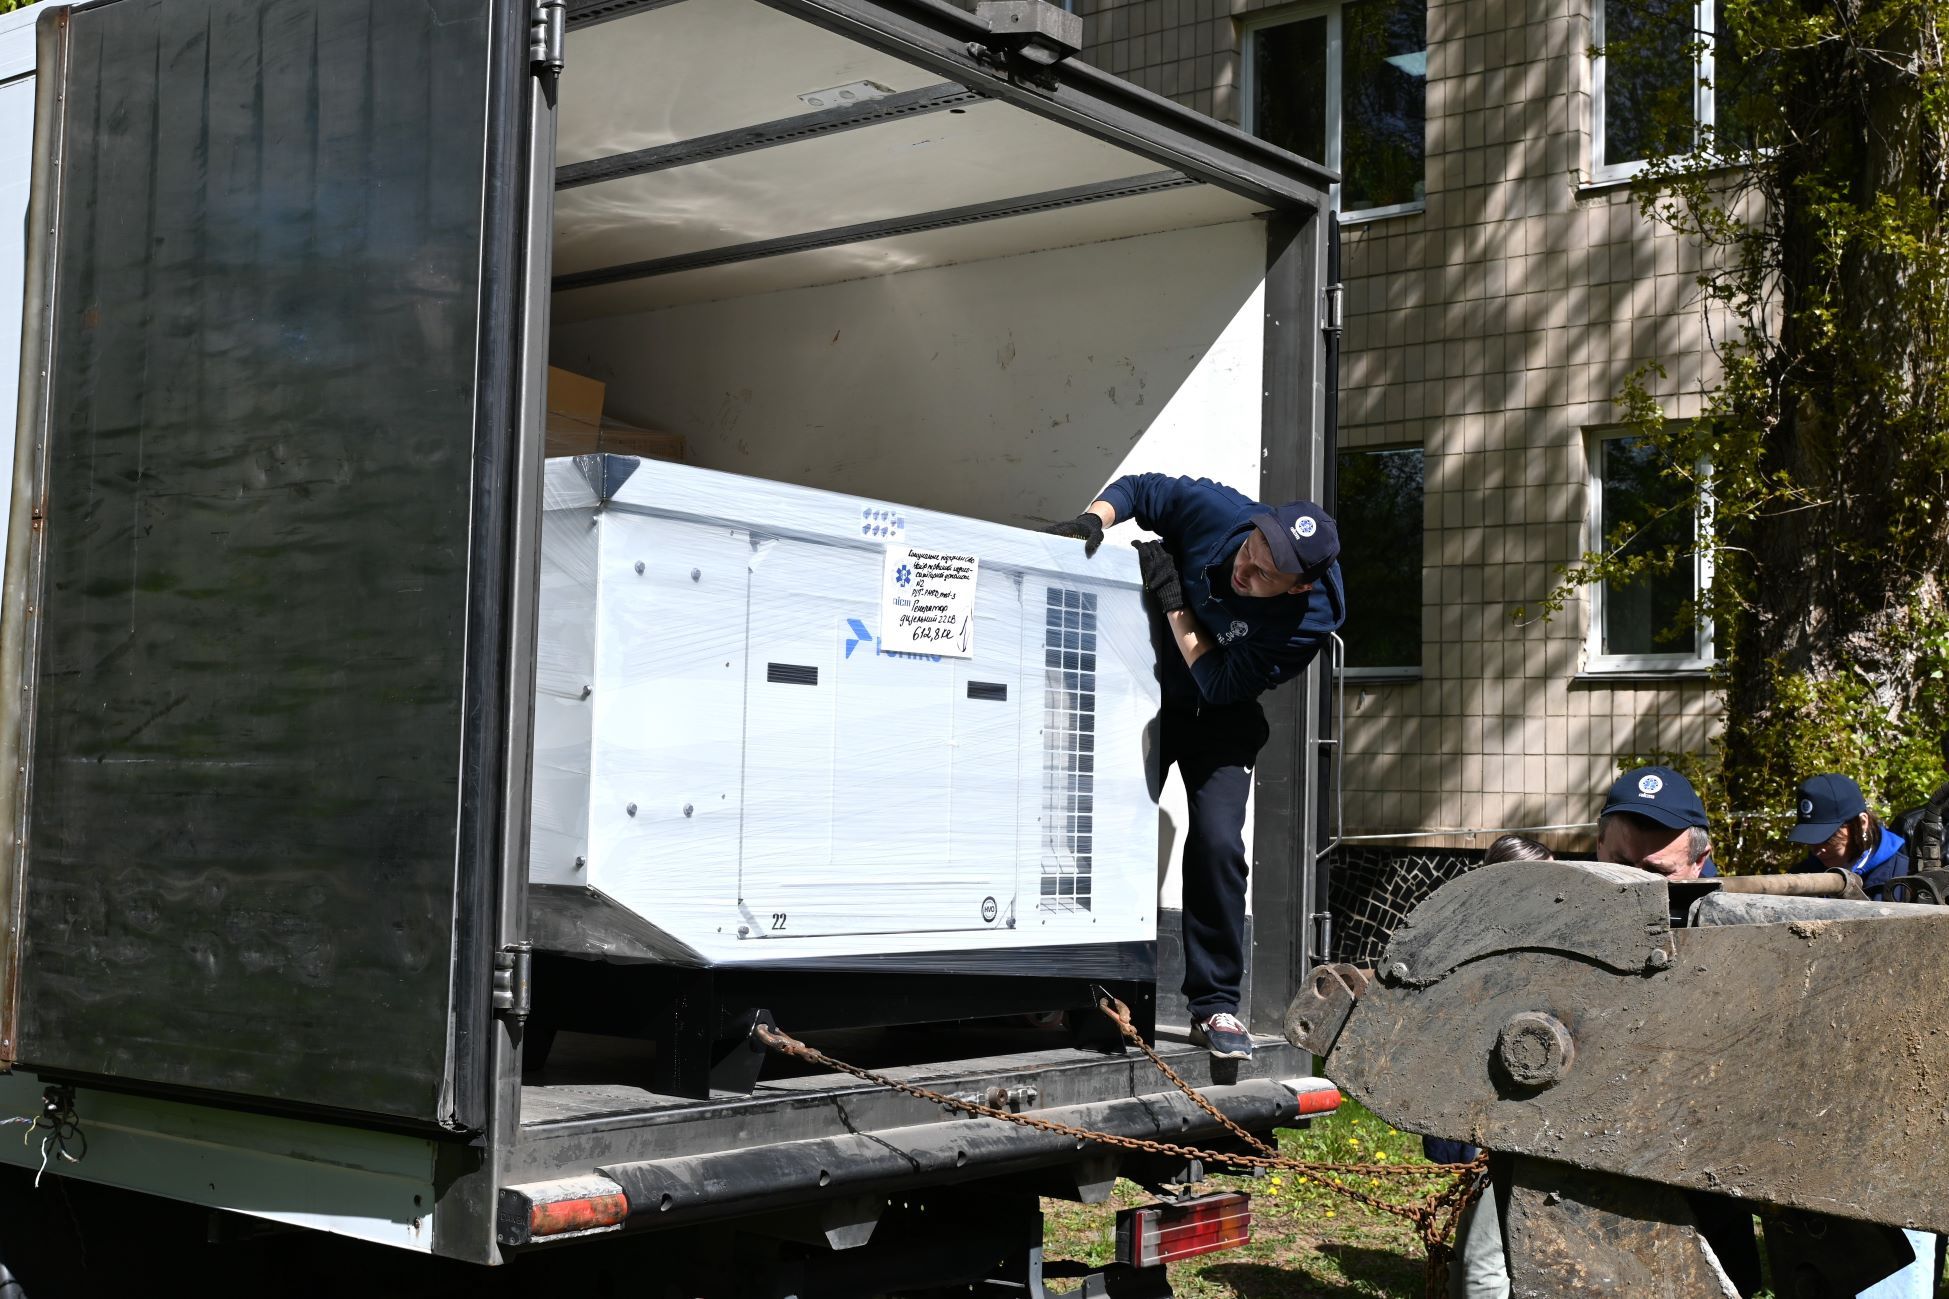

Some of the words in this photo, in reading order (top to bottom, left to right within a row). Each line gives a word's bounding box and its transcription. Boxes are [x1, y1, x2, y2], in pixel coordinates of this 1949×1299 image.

[911, 599, 948, 614] Генератор
[984, 905, 995, 913] HVO
[771, 913, 787, 930] 22
